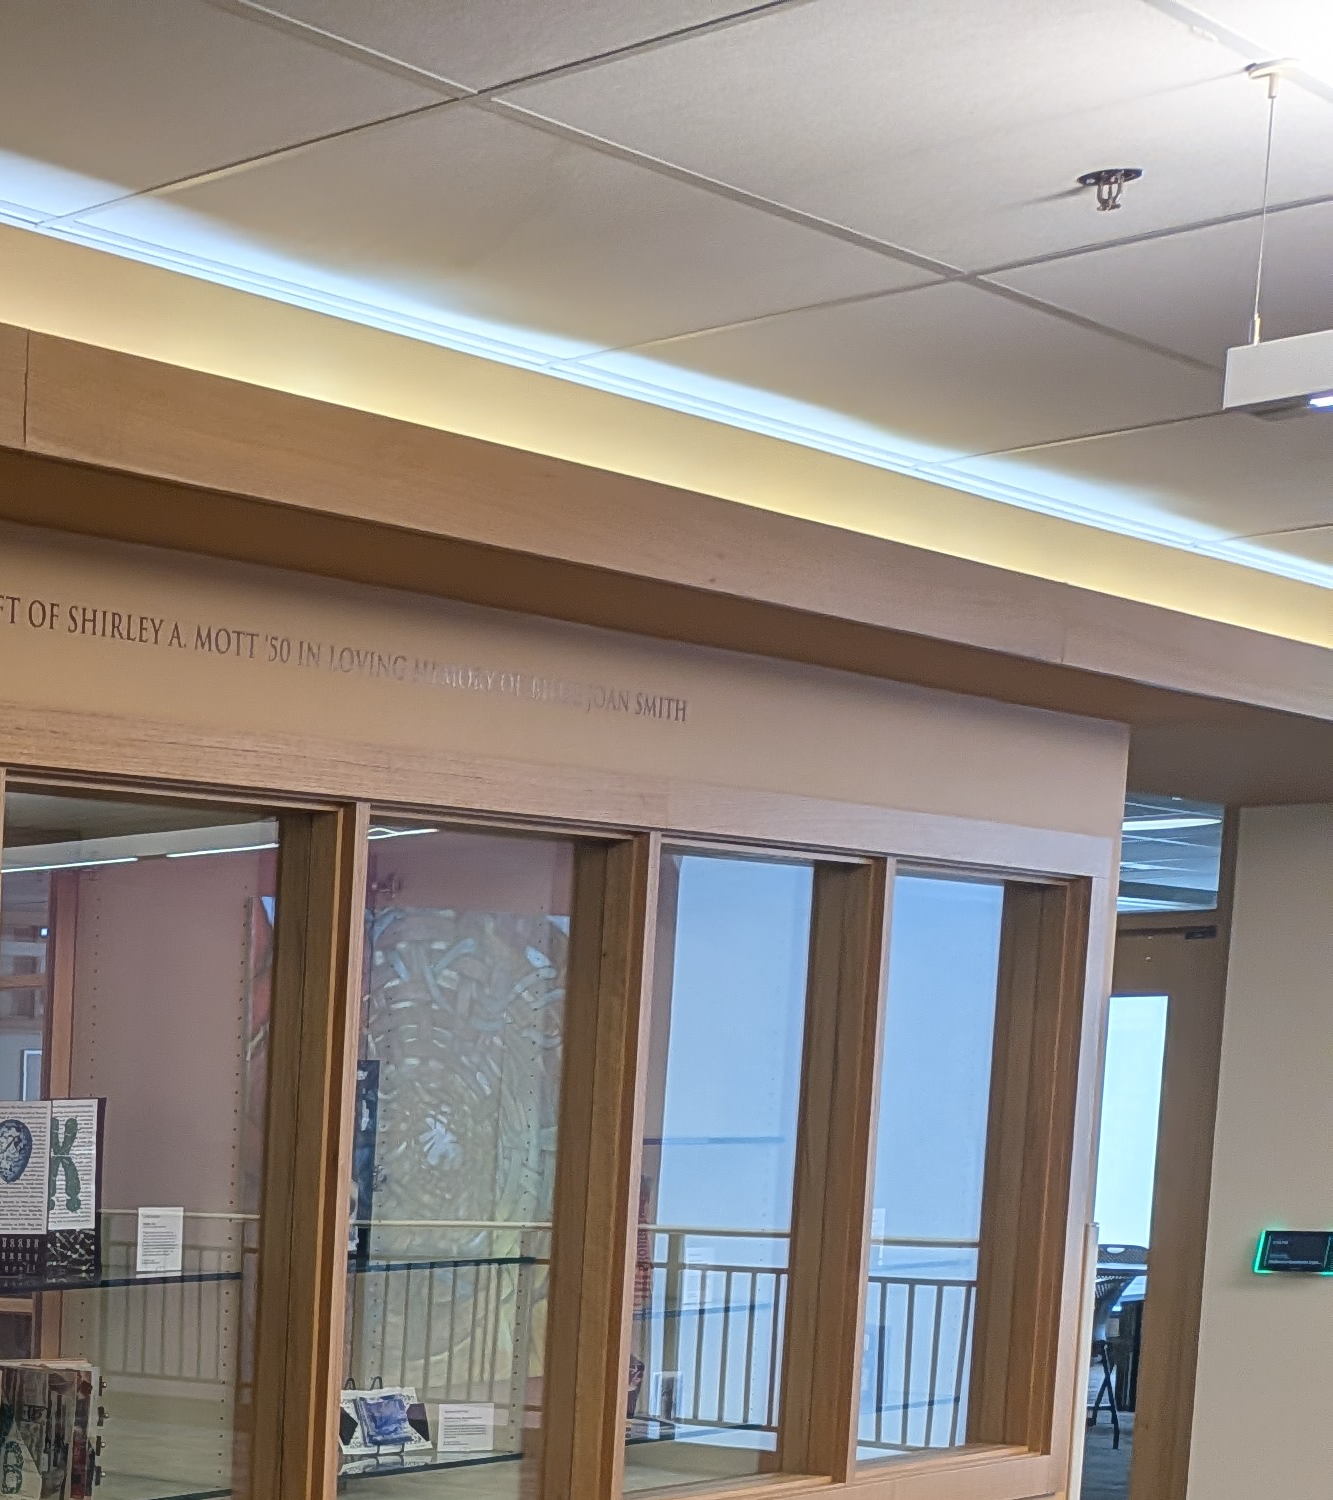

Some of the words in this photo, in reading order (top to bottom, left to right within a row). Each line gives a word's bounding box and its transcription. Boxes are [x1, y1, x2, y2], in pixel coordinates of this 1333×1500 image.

[28, 600, 59, 630] OF
[67, 605, 165, 645] SHIRLEY
[167, 622, 187, 649] A.
[194, 625, 259, 659] MOTT
[265, 635, 291, 664] '50
[298, 640, 321, 670] IN
[330, 645, 407, 682] LOVING
[634, 692, 687, 722] SMITH
